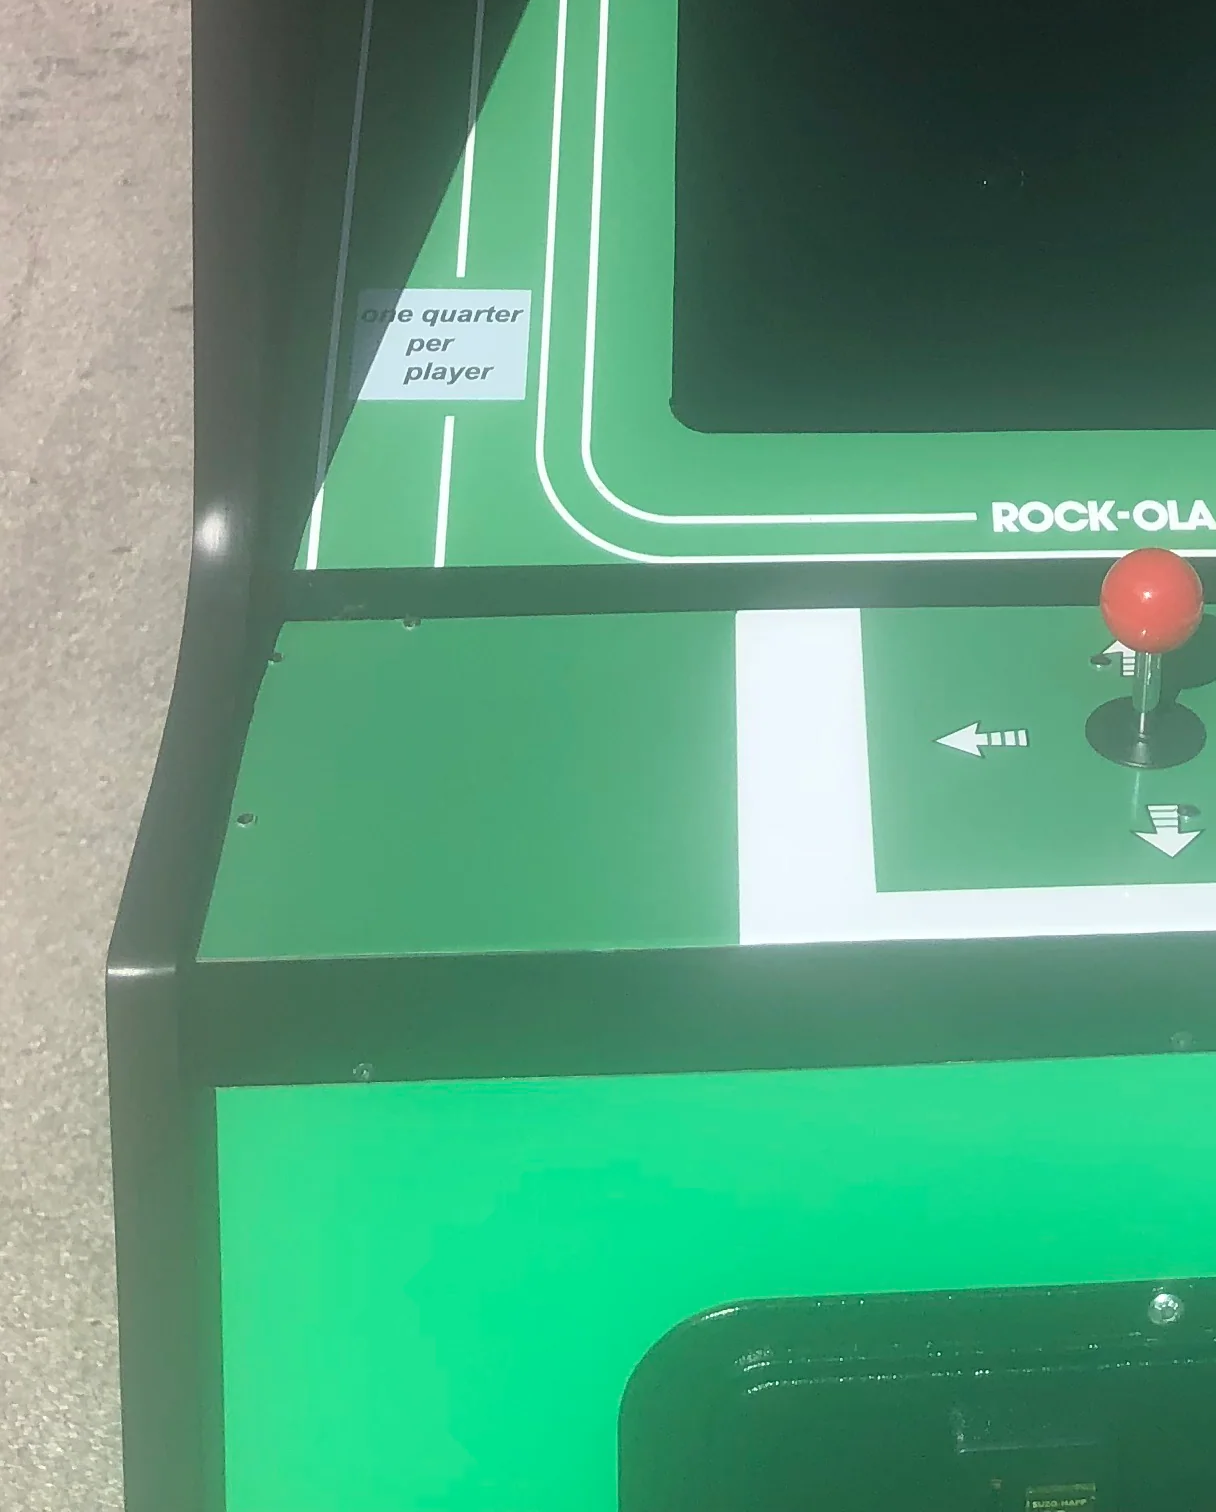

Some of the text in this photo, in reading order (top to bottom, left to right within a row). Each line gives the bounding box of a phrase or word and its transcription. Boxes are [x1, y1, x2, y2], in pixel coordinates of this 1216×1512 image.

[361, 305, 525, 327] one quarter
[405, 337, 456, 357] per
[403, 362, 495, 386] player
